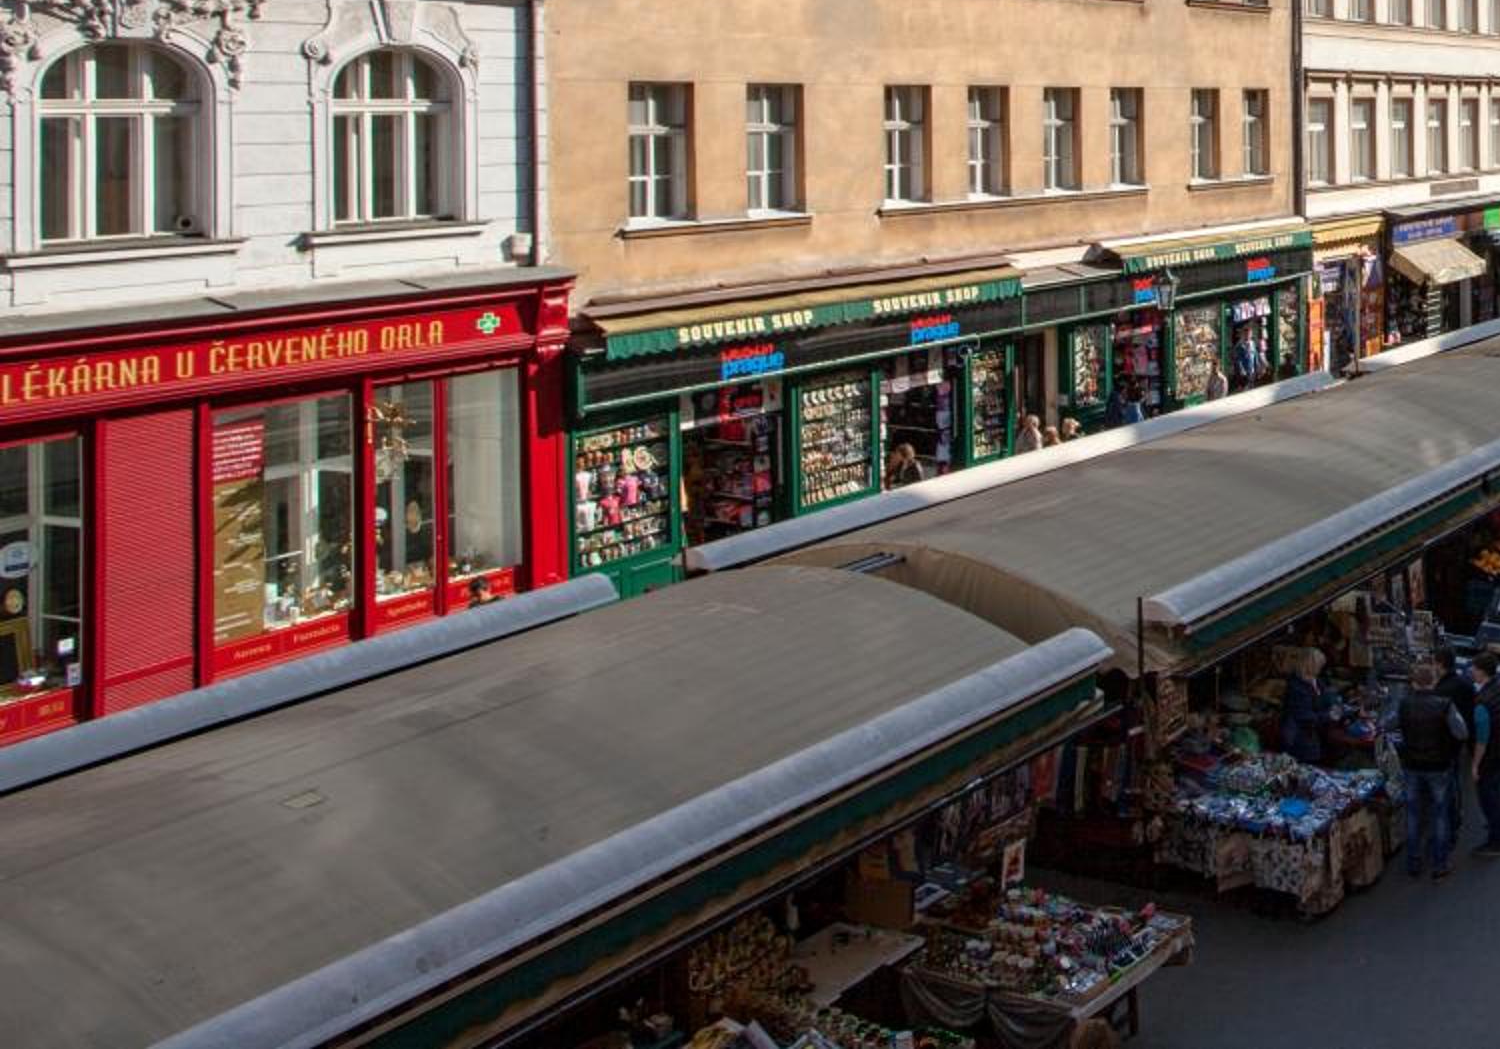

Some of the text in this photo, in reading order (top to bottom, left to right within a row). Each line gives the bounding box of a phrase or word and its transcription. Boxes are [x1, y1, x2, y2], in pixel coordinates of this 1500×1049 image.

[873, 286, 979, 313] SOUVENIR SHOP
[679, 310, 813, 343] SOUVENIR SHOP
[2, 320, 443, 403] LÉKÁRNA U ČERVENÉHO ORLA
